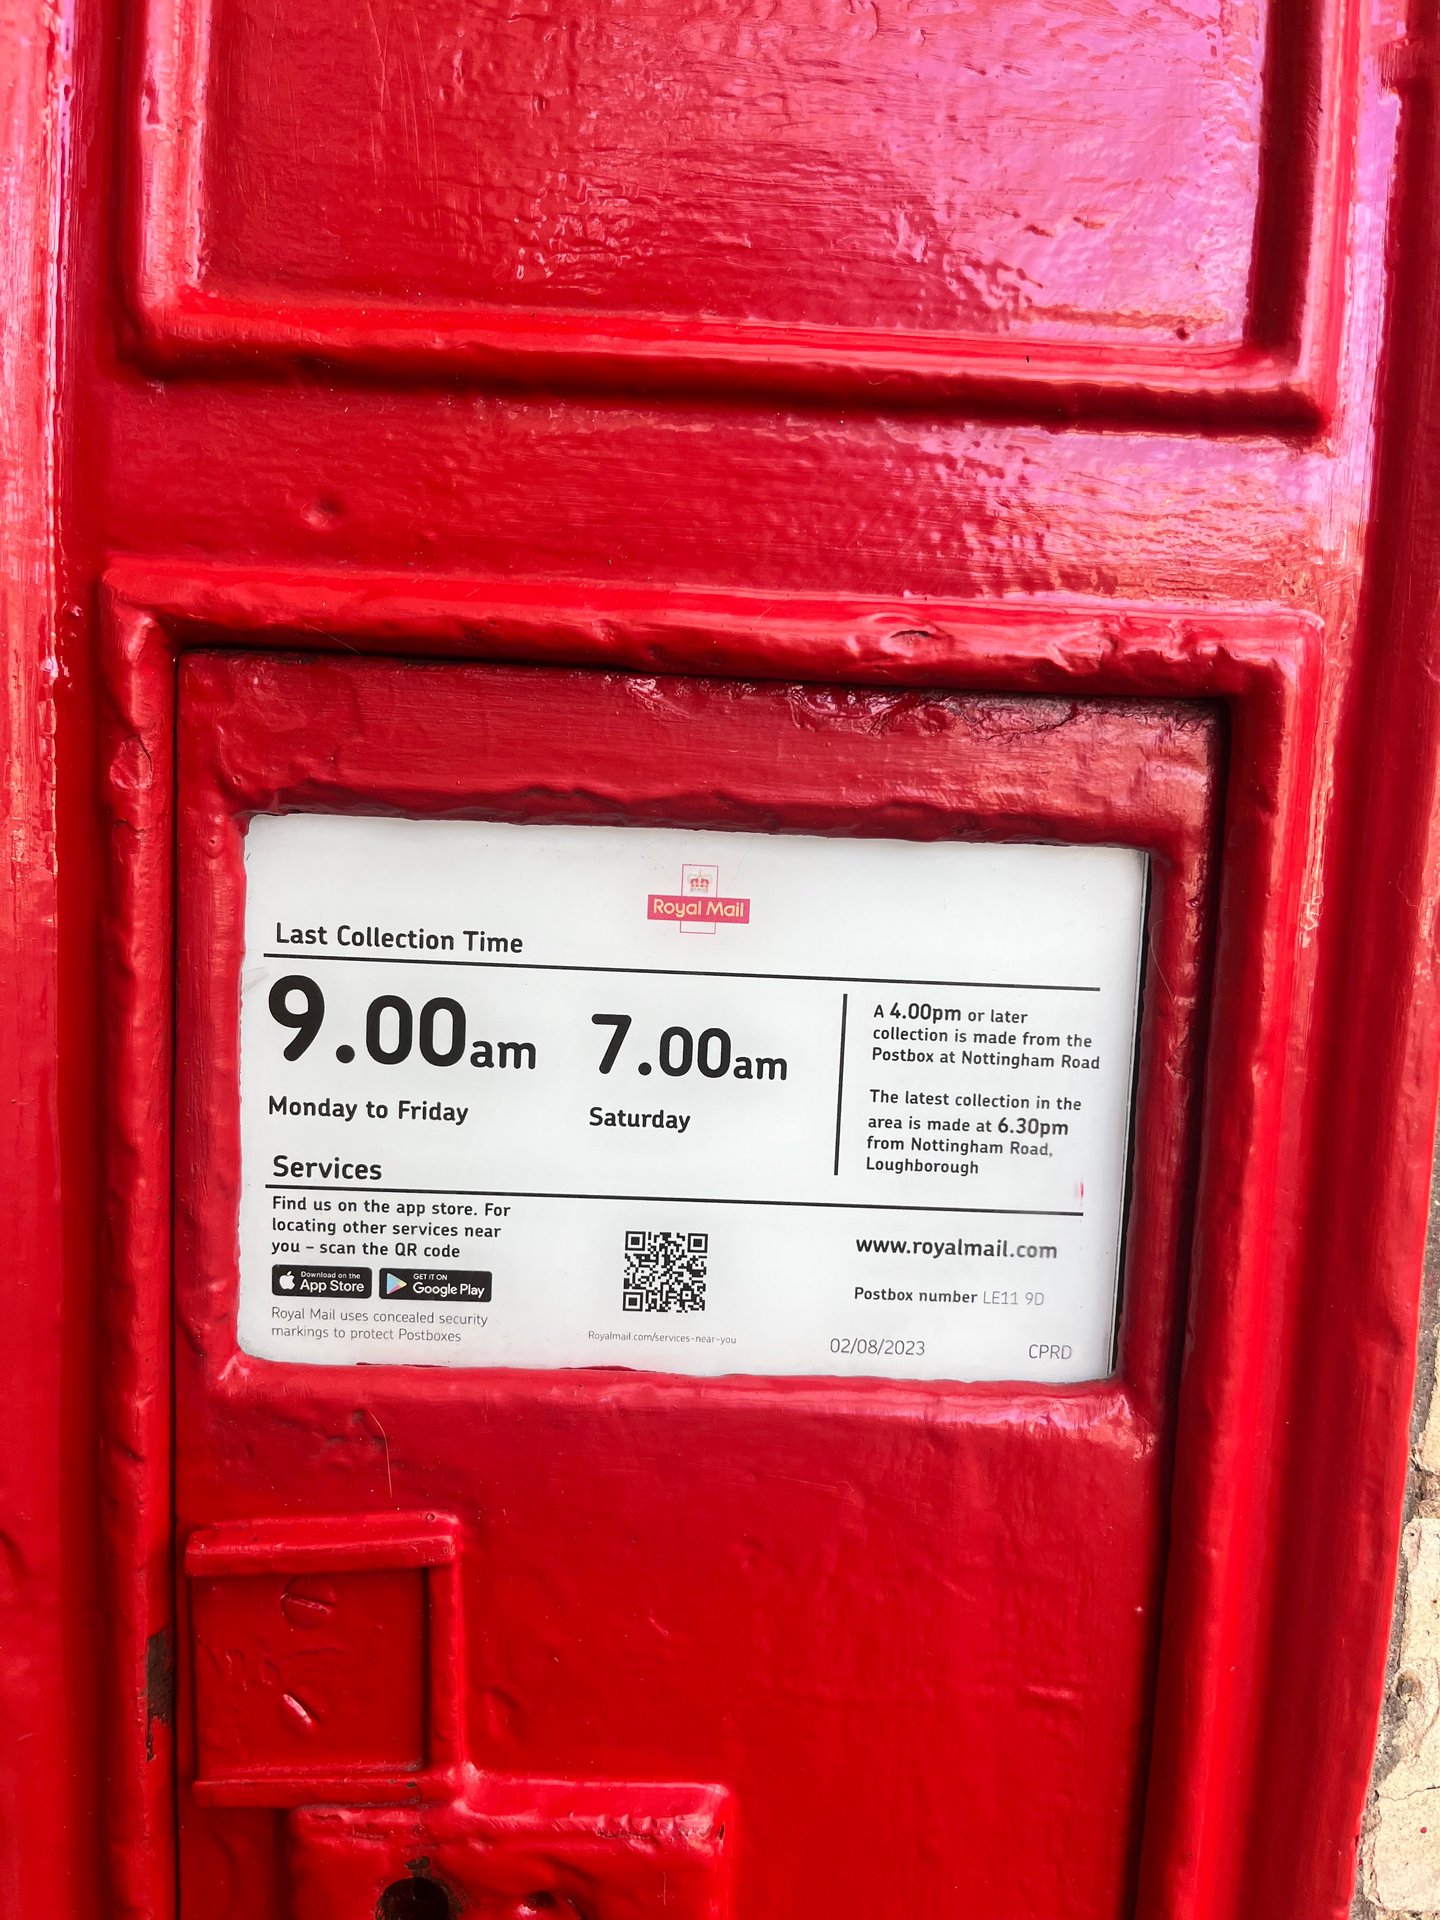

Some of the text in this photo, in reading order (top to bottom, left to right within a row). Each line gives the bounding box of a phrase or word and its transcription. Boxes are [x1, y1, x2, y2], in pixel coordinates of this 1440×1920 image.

[654, 898, 744, 918] Royal Mail
[276, 922, 523, 953] Last Collection Time
[268, 975, 536, 1070] 9.00am
[874, 1002, 1028, 1024] A 4.00pm or later
[591, 1014, 787, 1081] 7.00am
[873, 1026, 1092, 1048] collection is made from the
[872, 1047, 1100, 1069] Postbox at Nottingham Road
[269, 1095, 468, 1126] Monday to Friday
[869, 1089, 1081, 1111] The latest collection in the
[589, 1107, 691, 1133] Saturday
[868, 1116, 1068, 1138] area is made at 6.30pm
[867, 1135, 1053, 1157] from Nottingham Road,
[273, 1155, 382, 1180] Services
[866, 1156, 978, 1177] Loughborough
[273, 1196, 511, 1217] Find us on the app store. For
[273, 1217, 501, 1238] locating other services near
[271, 1242, 300, 1255] you
[320, 1243, 355, 1254] scan
[362, 1242, 388, 1255] the
[395, 1242, 417, 1256] QR
[424, 1244, 460, 1258] code
[856, 1238, 1057, 1259] www.royalmail.com
[300, 1279, 364, 1293] App Store
[412, 1282, 485, 1298] Google Play
[854, 1287, 1044, 1306] Postbox number LE11 9D
[272, 1306, 488, 1328] Royal Mail uses concealed security
[272, 1325, 461, 1342] markings to protect Postboxes
[588, 1330, 736, 1345] Royalmail.com/services-near-you
[830, 1338, 925, 1356] 02/08/2023
[1029, 1344, 1072, 1360] CPRD
